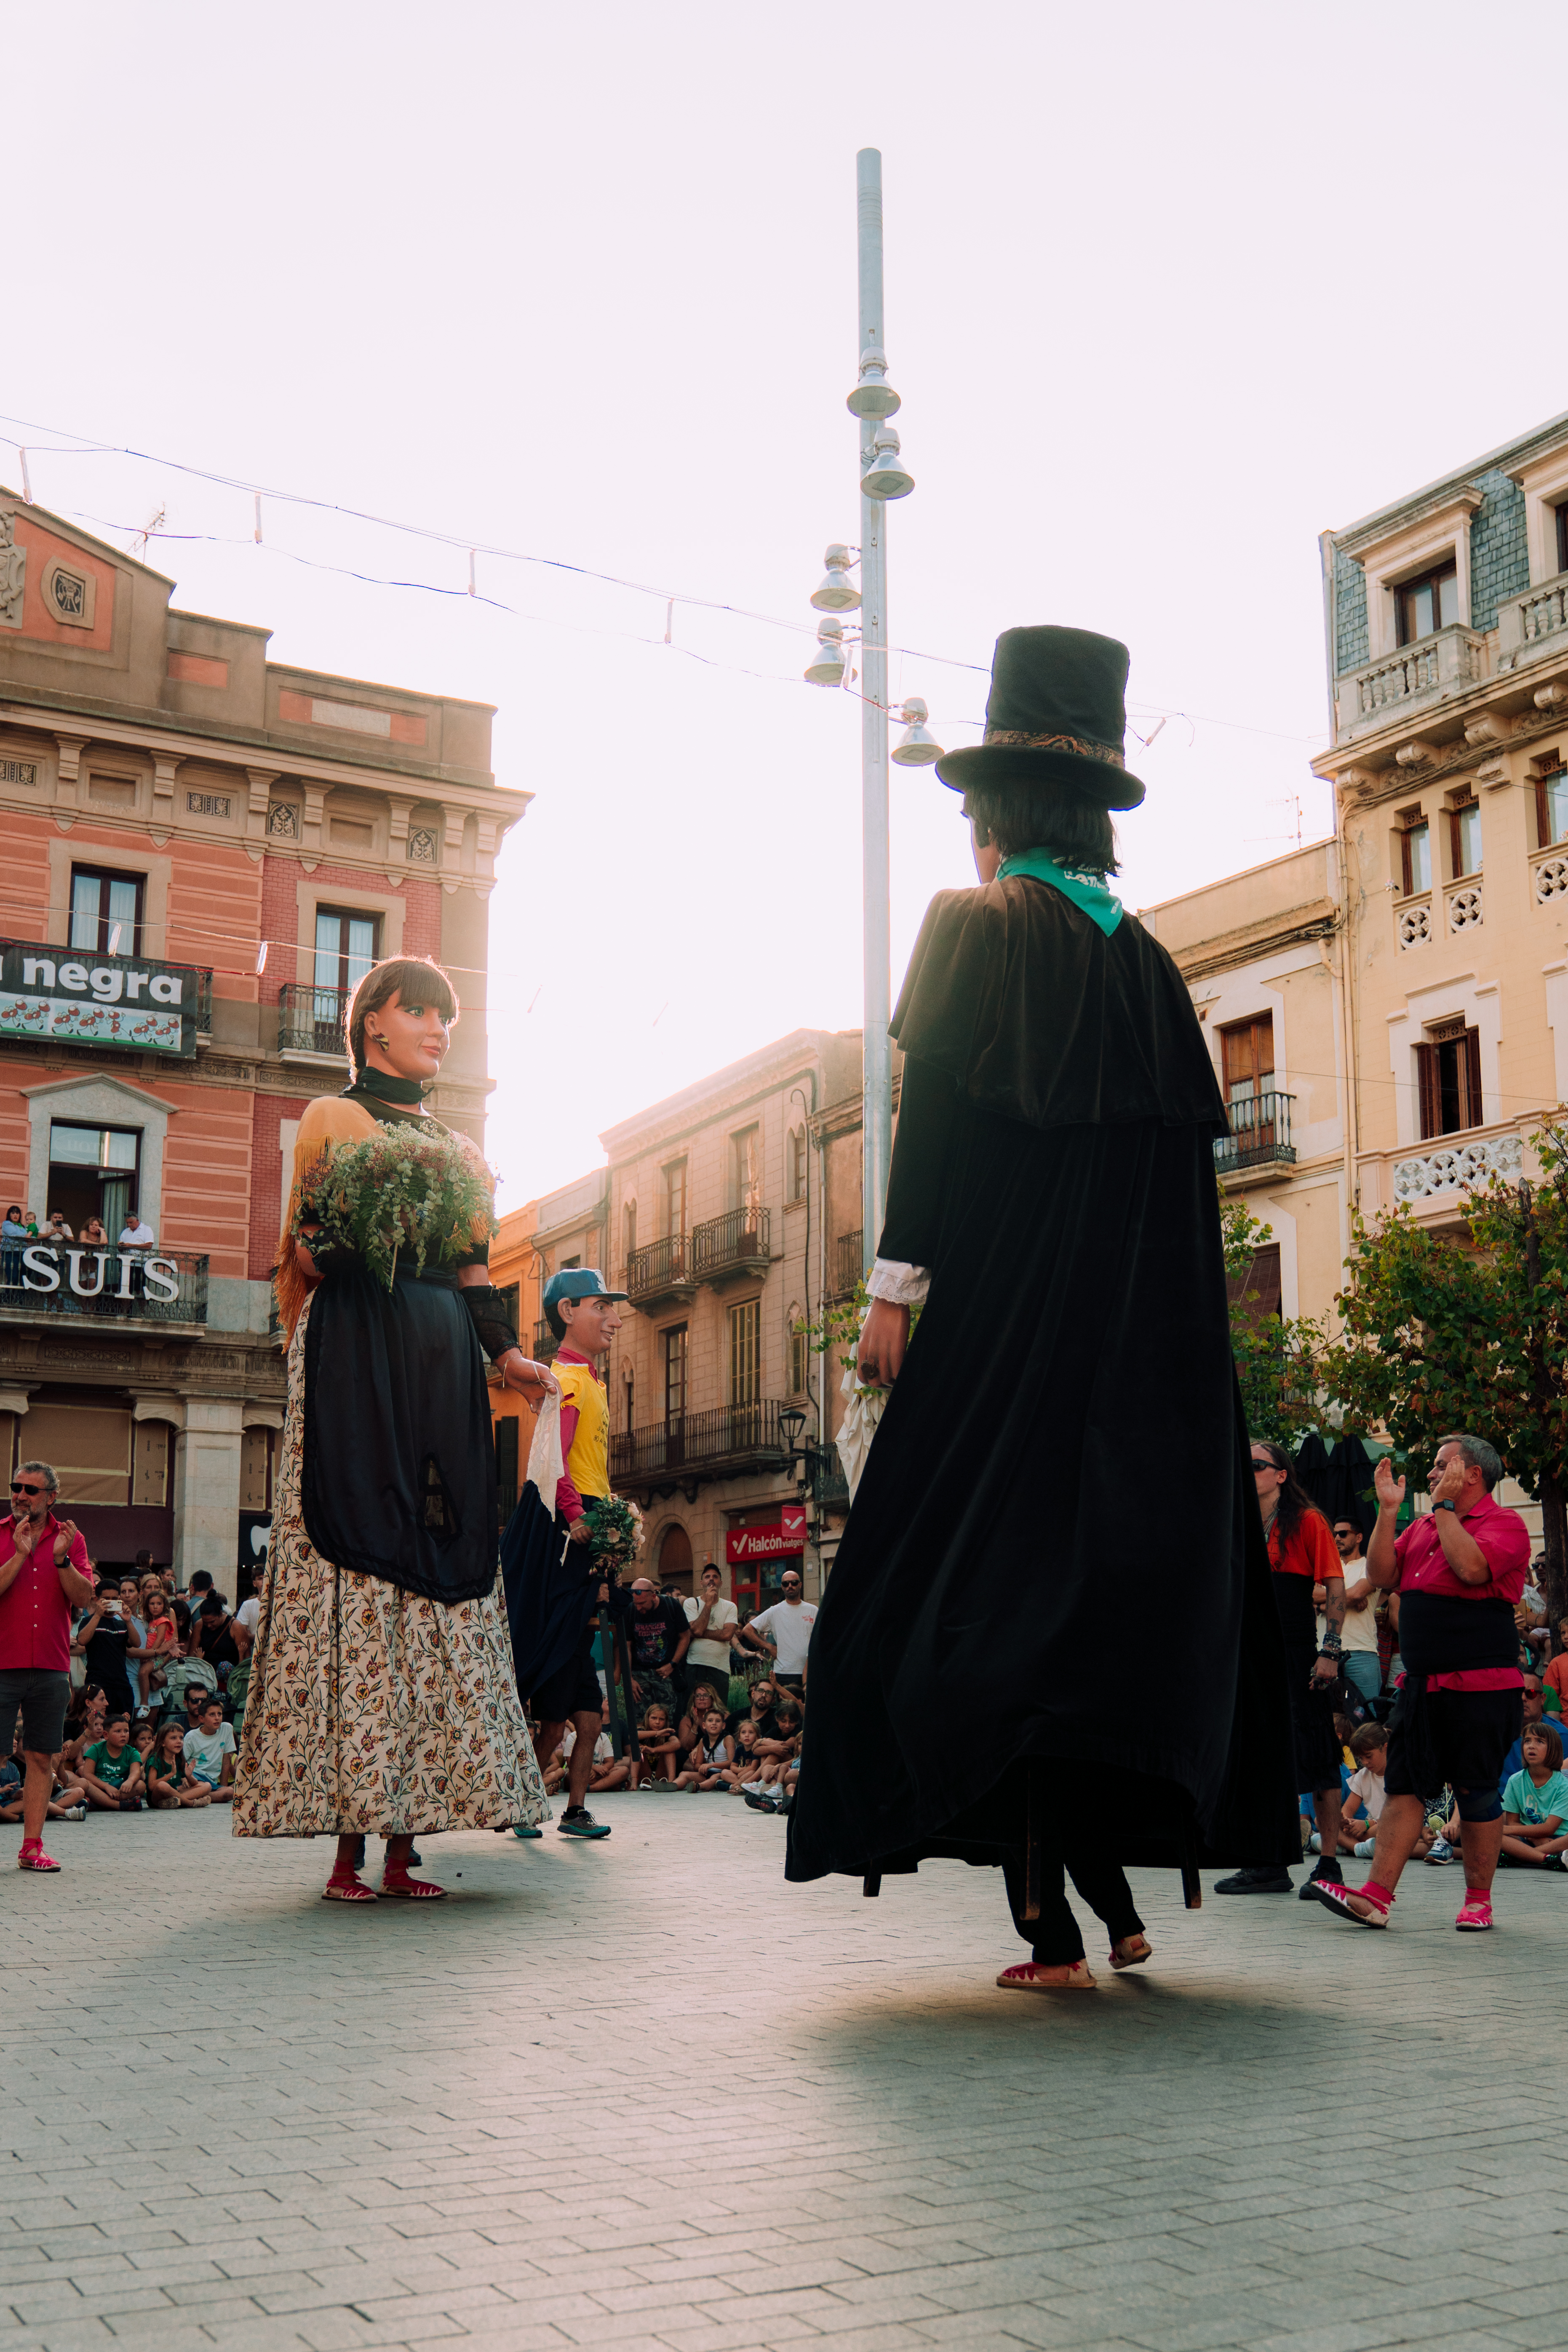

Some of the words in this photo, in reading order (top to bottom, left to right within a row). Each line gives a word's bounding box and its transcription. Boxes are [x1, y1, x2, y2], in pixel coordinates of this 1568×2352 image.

[23, 957, 183, 1004] negra
[22, 1246, 179, 1303] SUIS
[748, 1534, 782, 1553] Halcón
[782, 1538, 804, 1548] viatges
